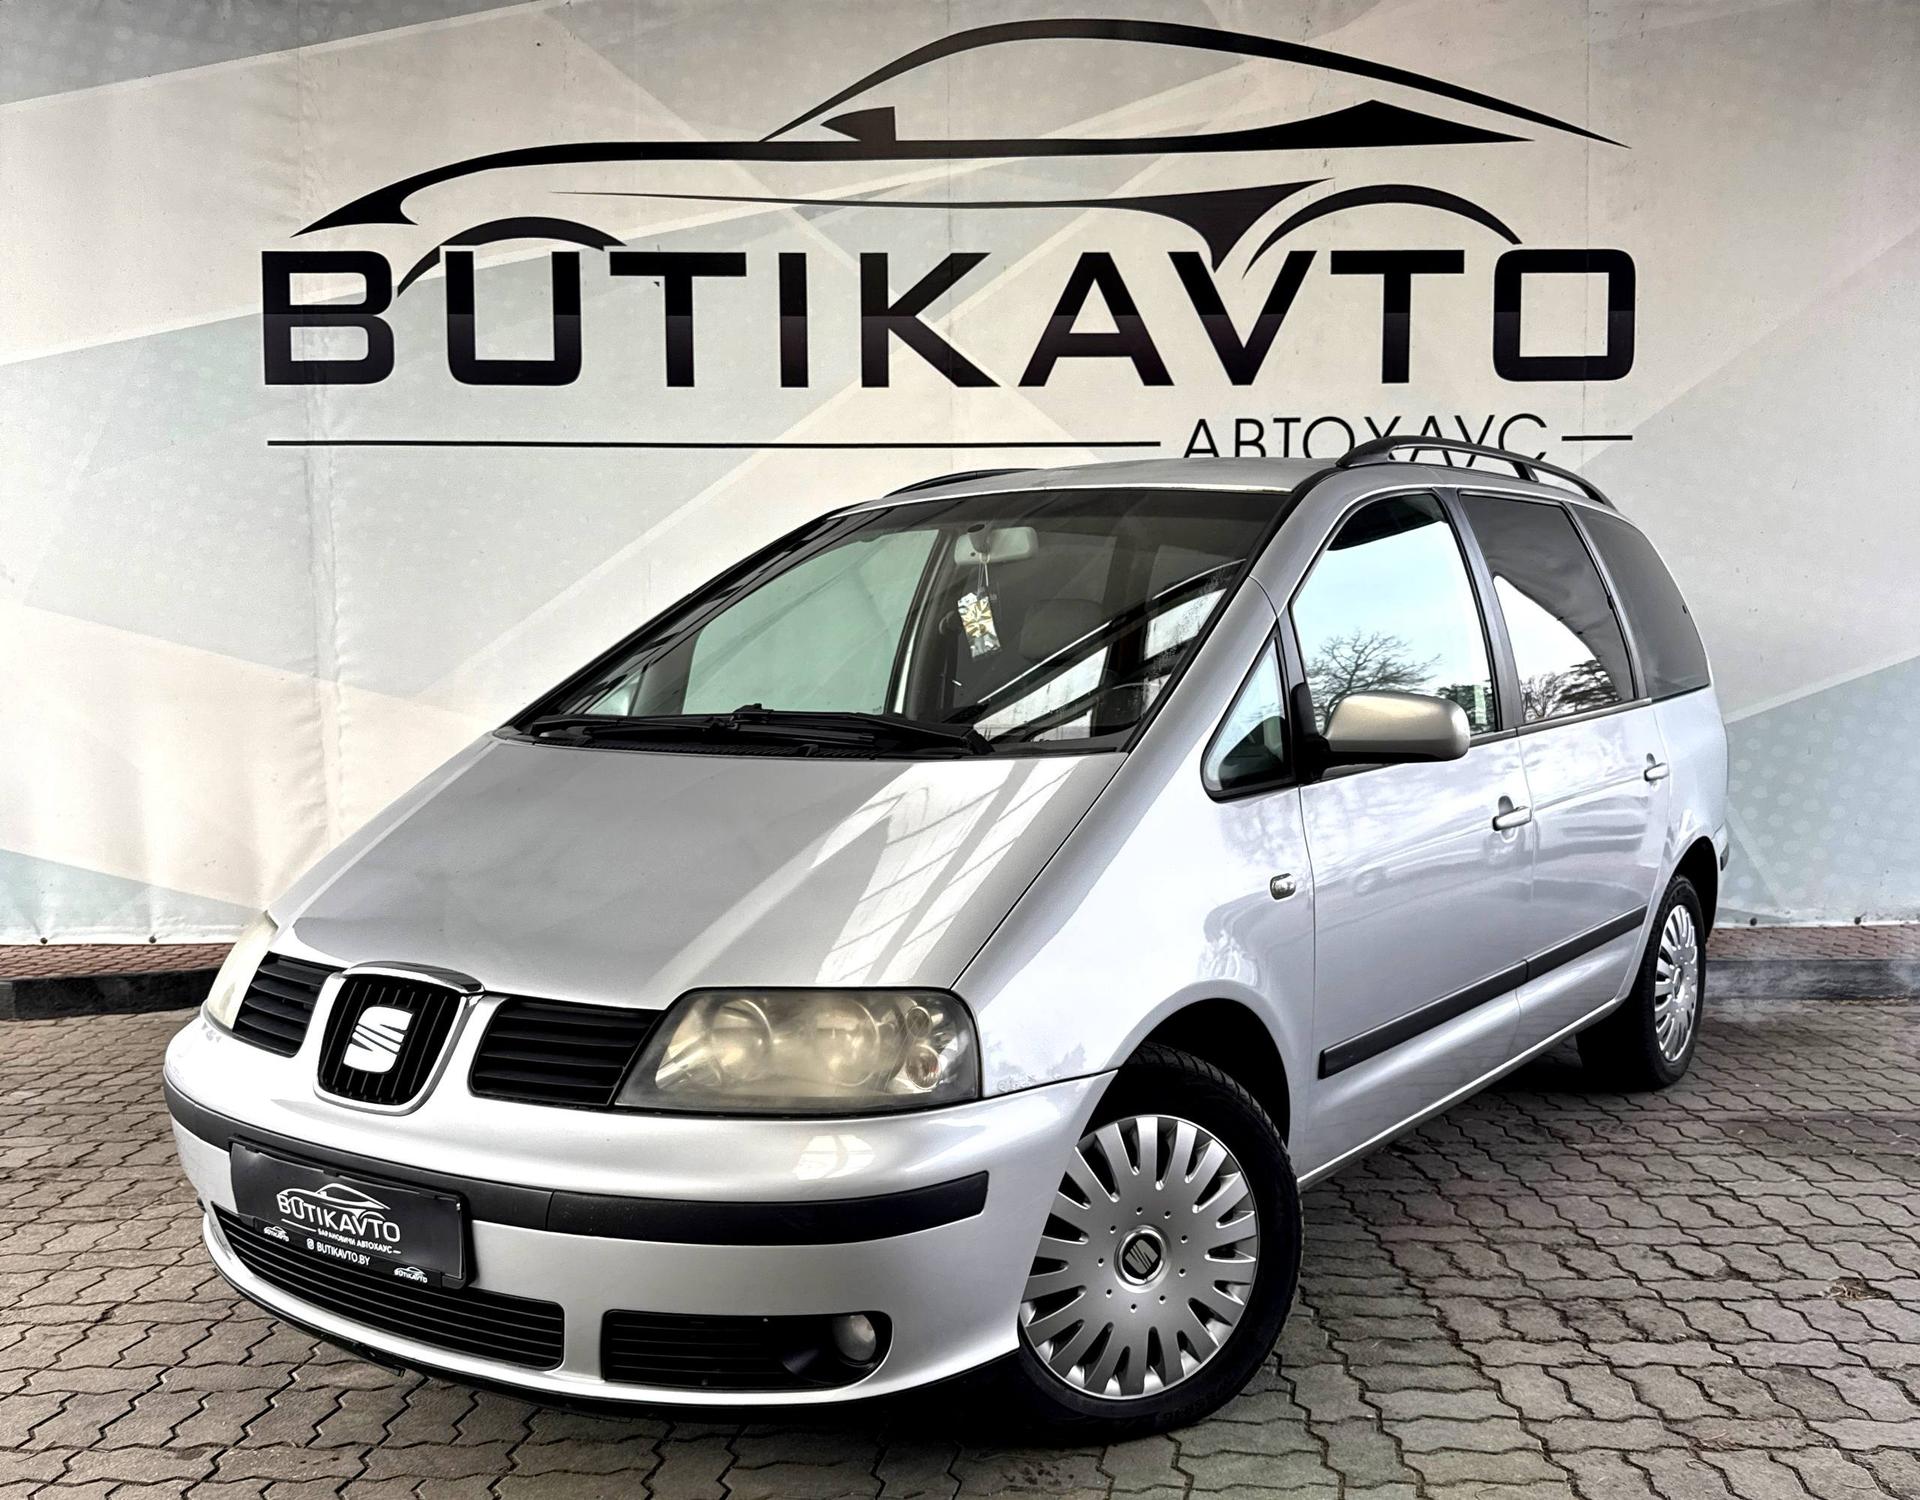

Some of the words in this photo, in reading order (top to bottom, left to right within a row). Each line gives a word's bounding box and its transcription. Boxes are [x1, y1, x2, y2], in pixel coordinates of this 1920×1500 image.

[262, 249, 1636, 388] BUTIKAVTO
[277, 1194, 401, 1243] BUTIKAVTO
[316, 1241, 371, 1266] BUTIKAVTO.BY
[356, 1240, 393, 1254] АВТОХАУС
